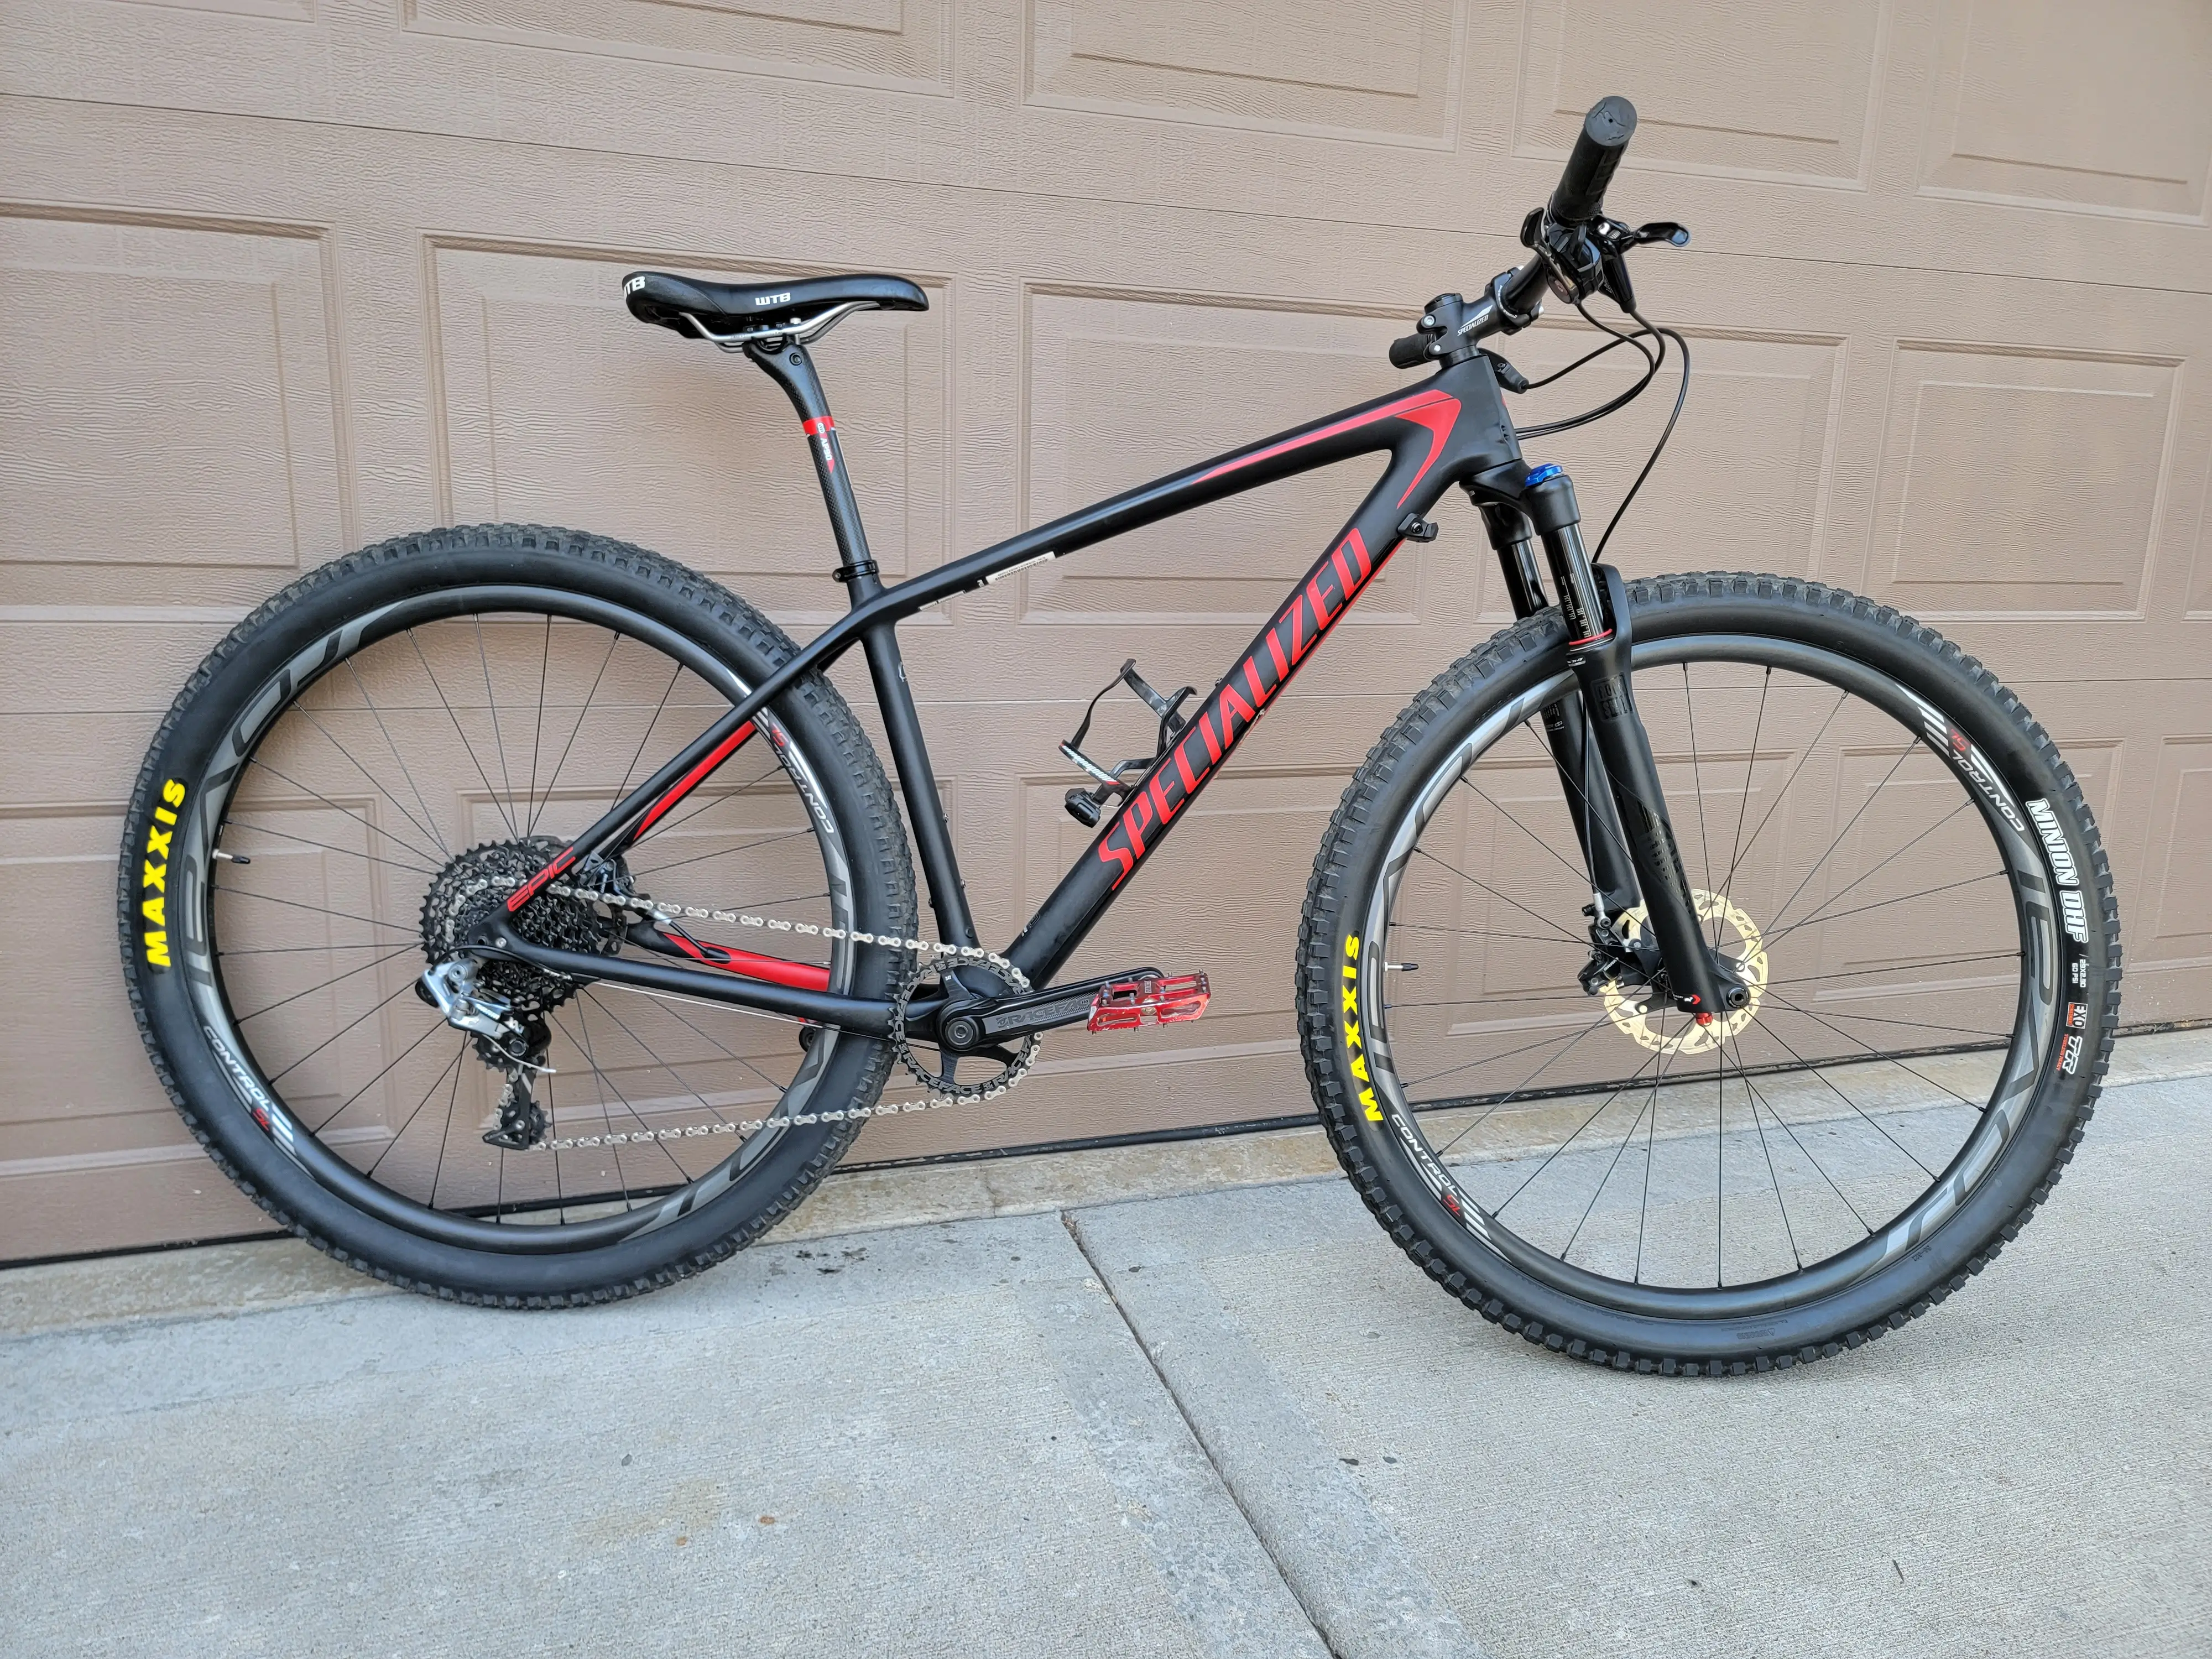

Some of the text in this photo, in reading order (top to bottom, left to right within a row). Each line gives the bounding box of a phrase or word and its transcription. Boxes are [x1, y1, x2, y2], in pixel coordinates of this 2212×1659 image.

[754, 292, 791, 306] WTB
[1457, 314, 1489, 337] SPECIALIZED
[1098, 528, 1371, 890] SPECIALIZED
[773, 742, 835, 834] CONTROL
[1952, 748, 2025, 832] CONTROL
[142, 779, 186, 968] MAXXIS
[507, 846, 576, 912] EPIC
[2026, 798, 2089, 944] MINION DHF
[2072, 962, 2079, 972] 60
[1341, 935, 1384, 1123] MAXXIS
[2062, 1035, 2083, 1075] TR
[2073, 1004, 2086, 1029] EXO
[203, 1024, 270, 1113] CONTROL
[1391, 1113, 1460, 1204] CONTROL
